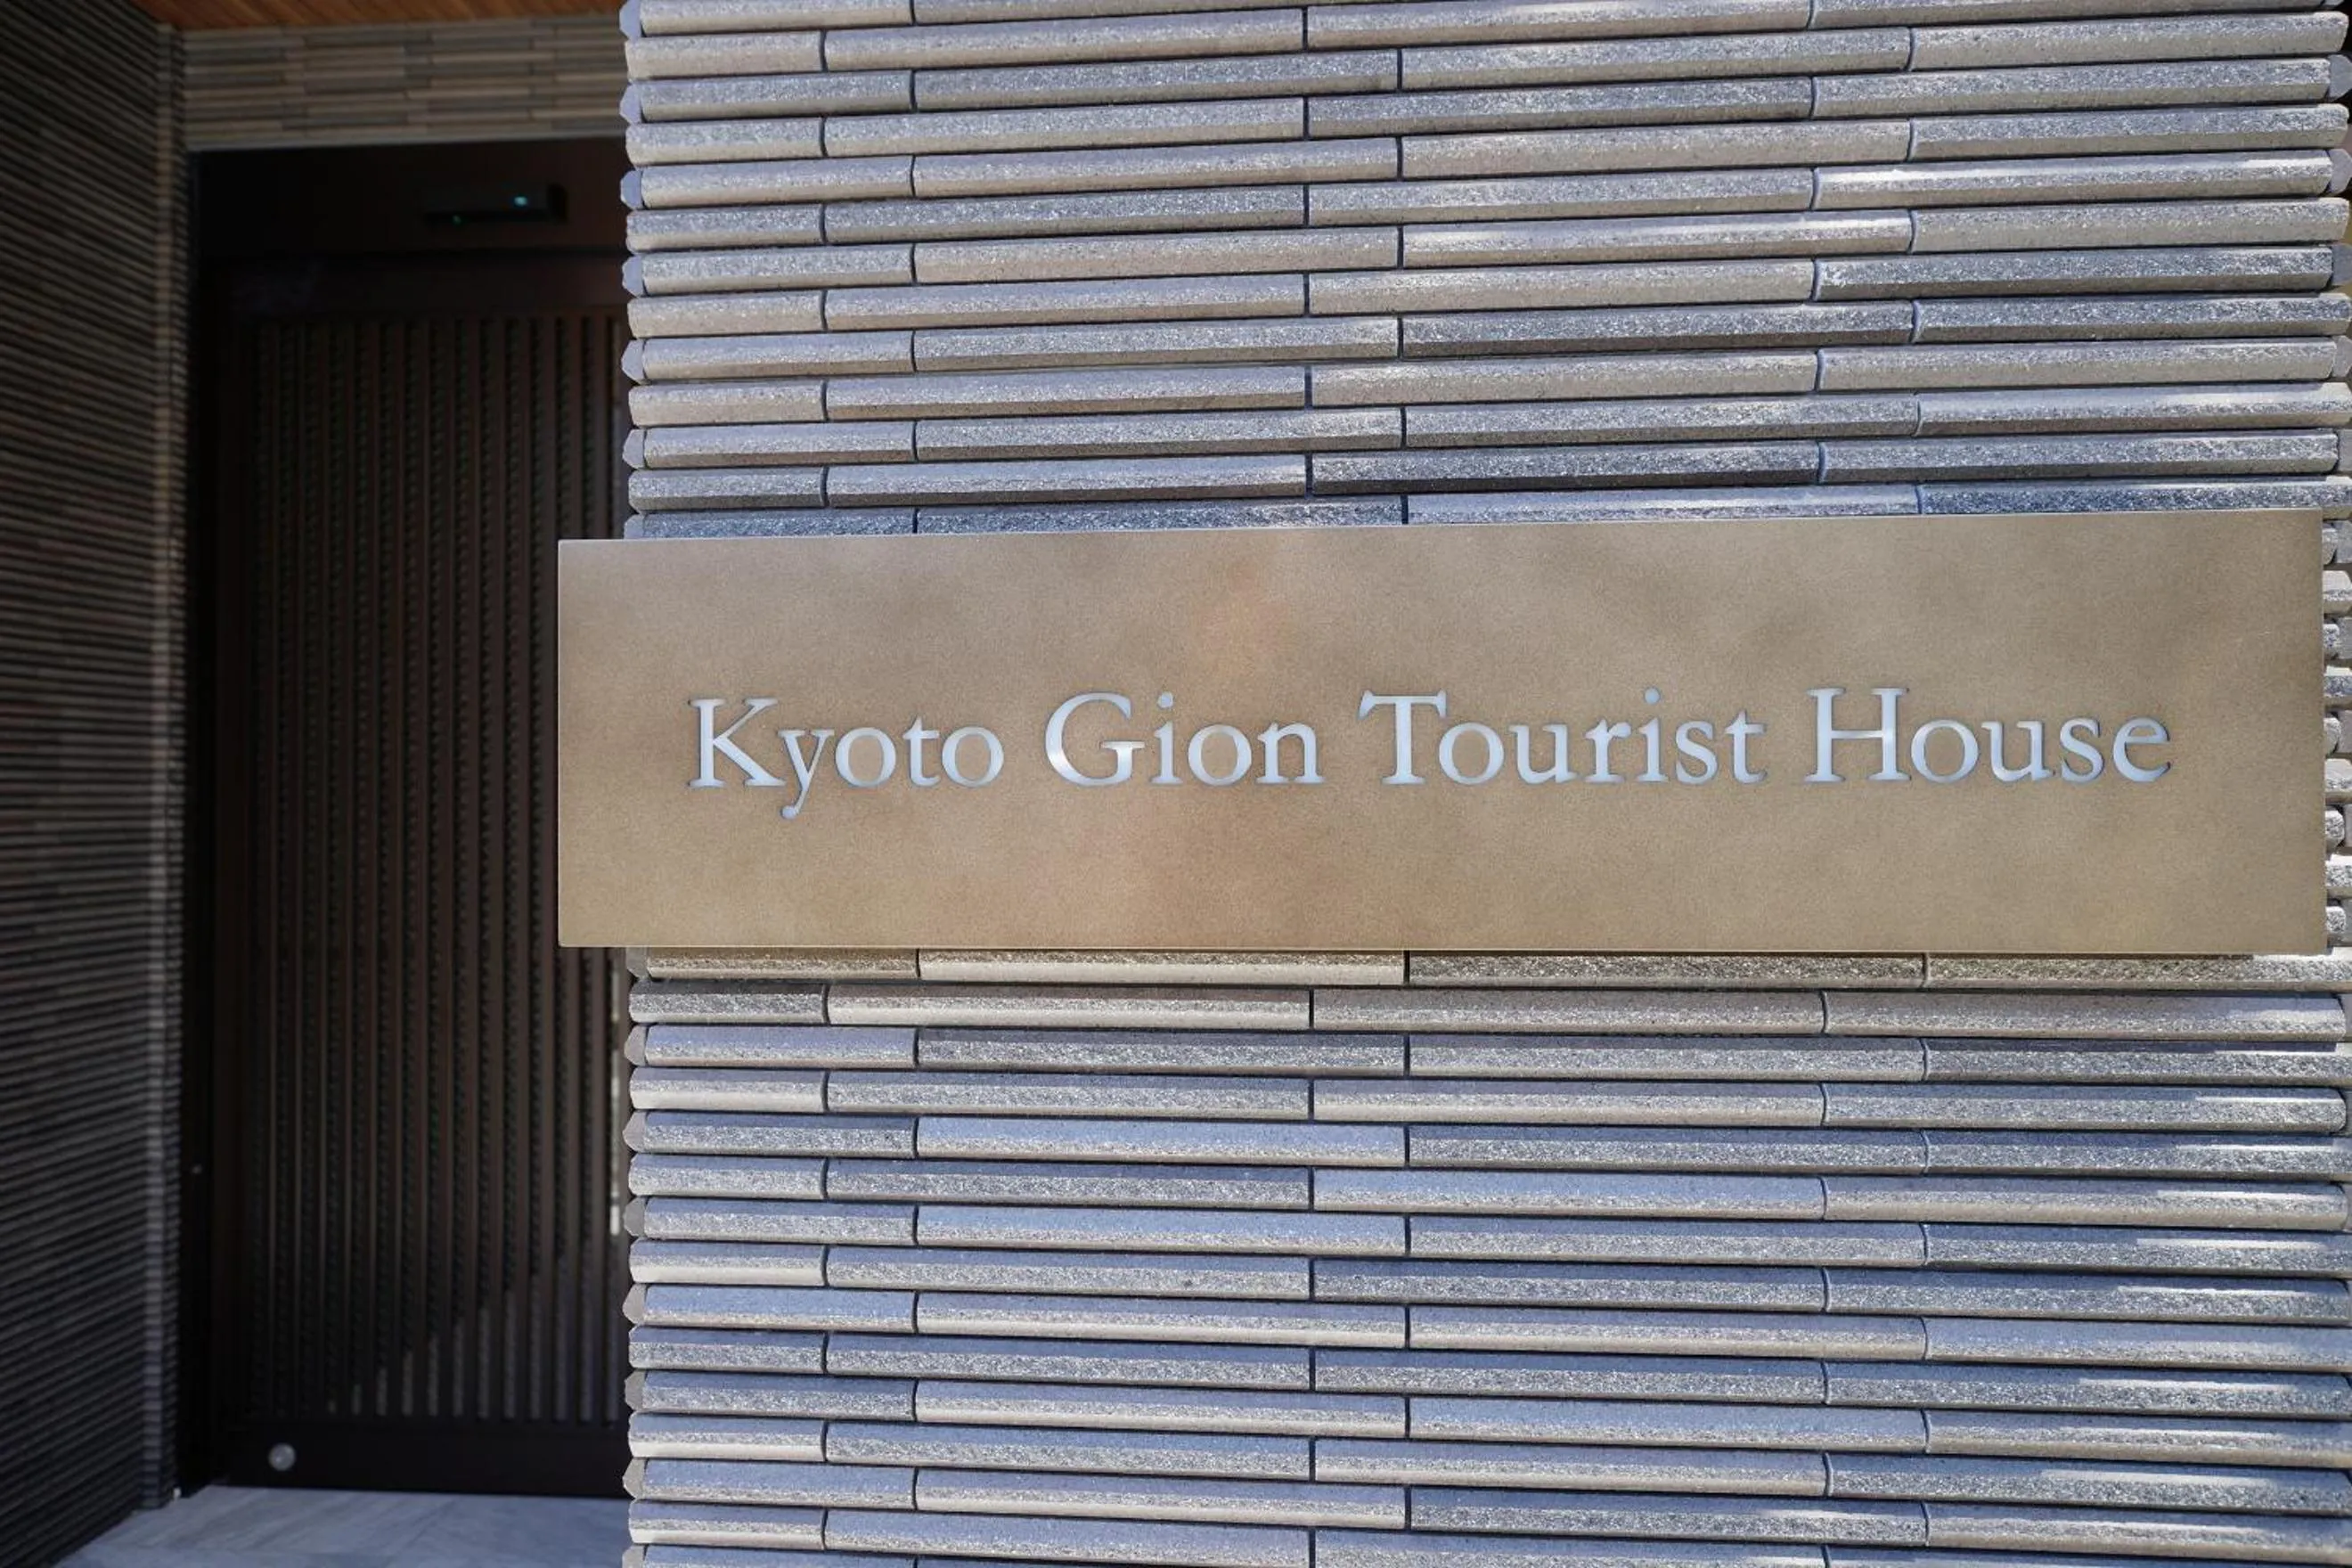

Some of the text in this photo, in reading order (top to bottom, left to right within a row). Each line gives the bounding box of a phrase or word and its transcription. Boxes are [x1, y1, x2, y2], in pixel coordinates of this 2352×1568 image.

[688, 687, 2172, 820] Kyoto Gion Tourist House
